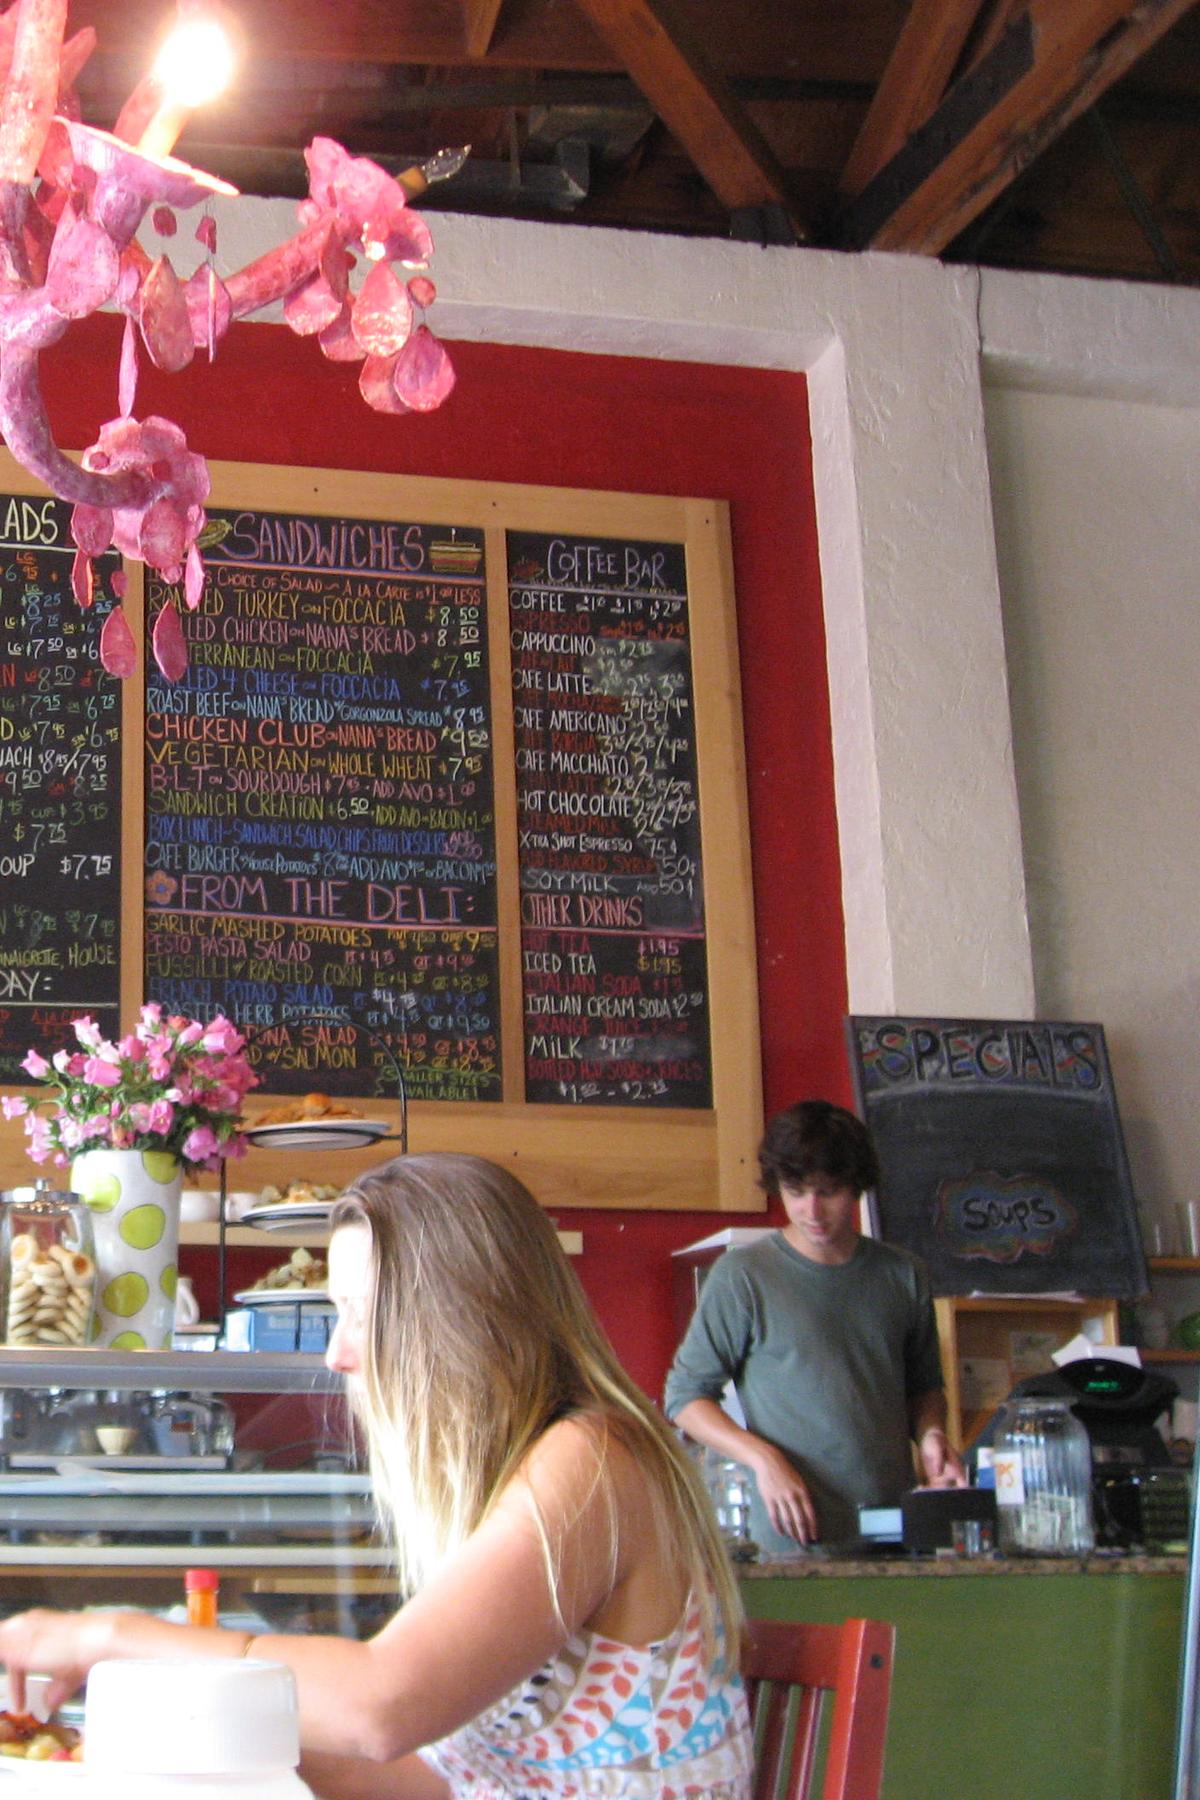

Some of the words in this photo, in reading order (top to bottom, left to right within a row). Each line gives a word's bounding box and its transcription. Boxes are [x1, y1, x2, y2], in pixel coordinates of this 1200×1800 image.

[218, 512, 426, 572] SANDWICHES
[624, 547, 665, 590] BAR
[217, 566, 256, 586] CHOICE
[280, 572, 323, 592] SALAD
[376, 580, 412, 601] CARTE
[233, 589, 300, 621] TURKEY
[323, 595, 407, 627] FOCCACIA
[509, 590, 566, 613] COFFEE
[223, 616, 289, 648] CHICKEN
[362, 626, 417, 656] BREAD
[511, 611, 592, 634] ESPRESSO
[511, 629, 596, 657] CAPPUCCINO
[296, 647, 374, 676] FOCCACIA
[321, 673, 402, 700] FOCCACIA
[511, 668, 545, 691] CAFE
[547, 671, 592, 695] LATTE
[147, 688, 192, 714] ROAST
[196, 692, 231, 717] BEEF
[289, 695, 335, 723] BREAD
[340, 705, 404, 724] GORGONZOLA
[146, 711, 248, 744] CHICKEN
[258, 718, 327, 749] CLUB
[386, 725, 437, 754] BREAD
[514, 706, 544, 731] CAFE
[549, 709, 627, 735] AMERICANO
[146, 740, 310, 775] VEGETARIAN
[328, 752, 377, 777] WHOLE
[382, 754, 438, 781] WHEAT
[515, 748, 545, 773] CAFE
[550, 750, 629, 777] MACCHIATO
[225, 767, 322, 795] SOURDOUGH
[372, 779, 395, 799] ADD
[398, 782, 433, 804] AVO
[148, 786, 238, 817] SANDWICH
[245, 790, 325, 820] CREATION
[518, 790, 545, 813] HOT
[549, 791, 635, 818] CHOCOLATE
[551, 832, 577, 851] SHOT
[579, 832, 633, 853] ESPRESSO
[188, 844, 241, 872] BURGER
[522, 870, 566, 891] SOY
[570, 875, 619, 894] MILK
[181, 873, 269, 912] FROM
[284, 876, 349, 917] THE
[367, 883, 475, 924] DELI:
[522, 894, 572, 927] OTHER
[579, 895, 644, 927] DRINKS
[147, 914, 206, 937] GARLIC
[211, 915, 286, 941] MASHED
[294, 925, 372, 948] POTATOES
[68, 942, 117, 968] HOUSE
[201, 936, 248, 959] PASTA
[254, 939, 312, 964] SALAD
[524, 951, 563, 973] ICED
[567, 953, 597, 976] TEA
[249, 960, 314, 985] ROASTED
[323, 963, 362, 986] CORN
[284, 983, 335, 1006] SALAD
[525, 993, 582, 1016] ITALIAN
[587, 996, 635, 1019] CREAM
[638, 997, 673, 1020] SODA
[234, 1003, 274, 1027] HERB
[302, 1026, 357, 1048] SALAD
[529, 1034, 584, 1061] MILK
[282, 1044, 357, 1070] SALMON
[874, 1023, 1103, 1090] SPECIALS
